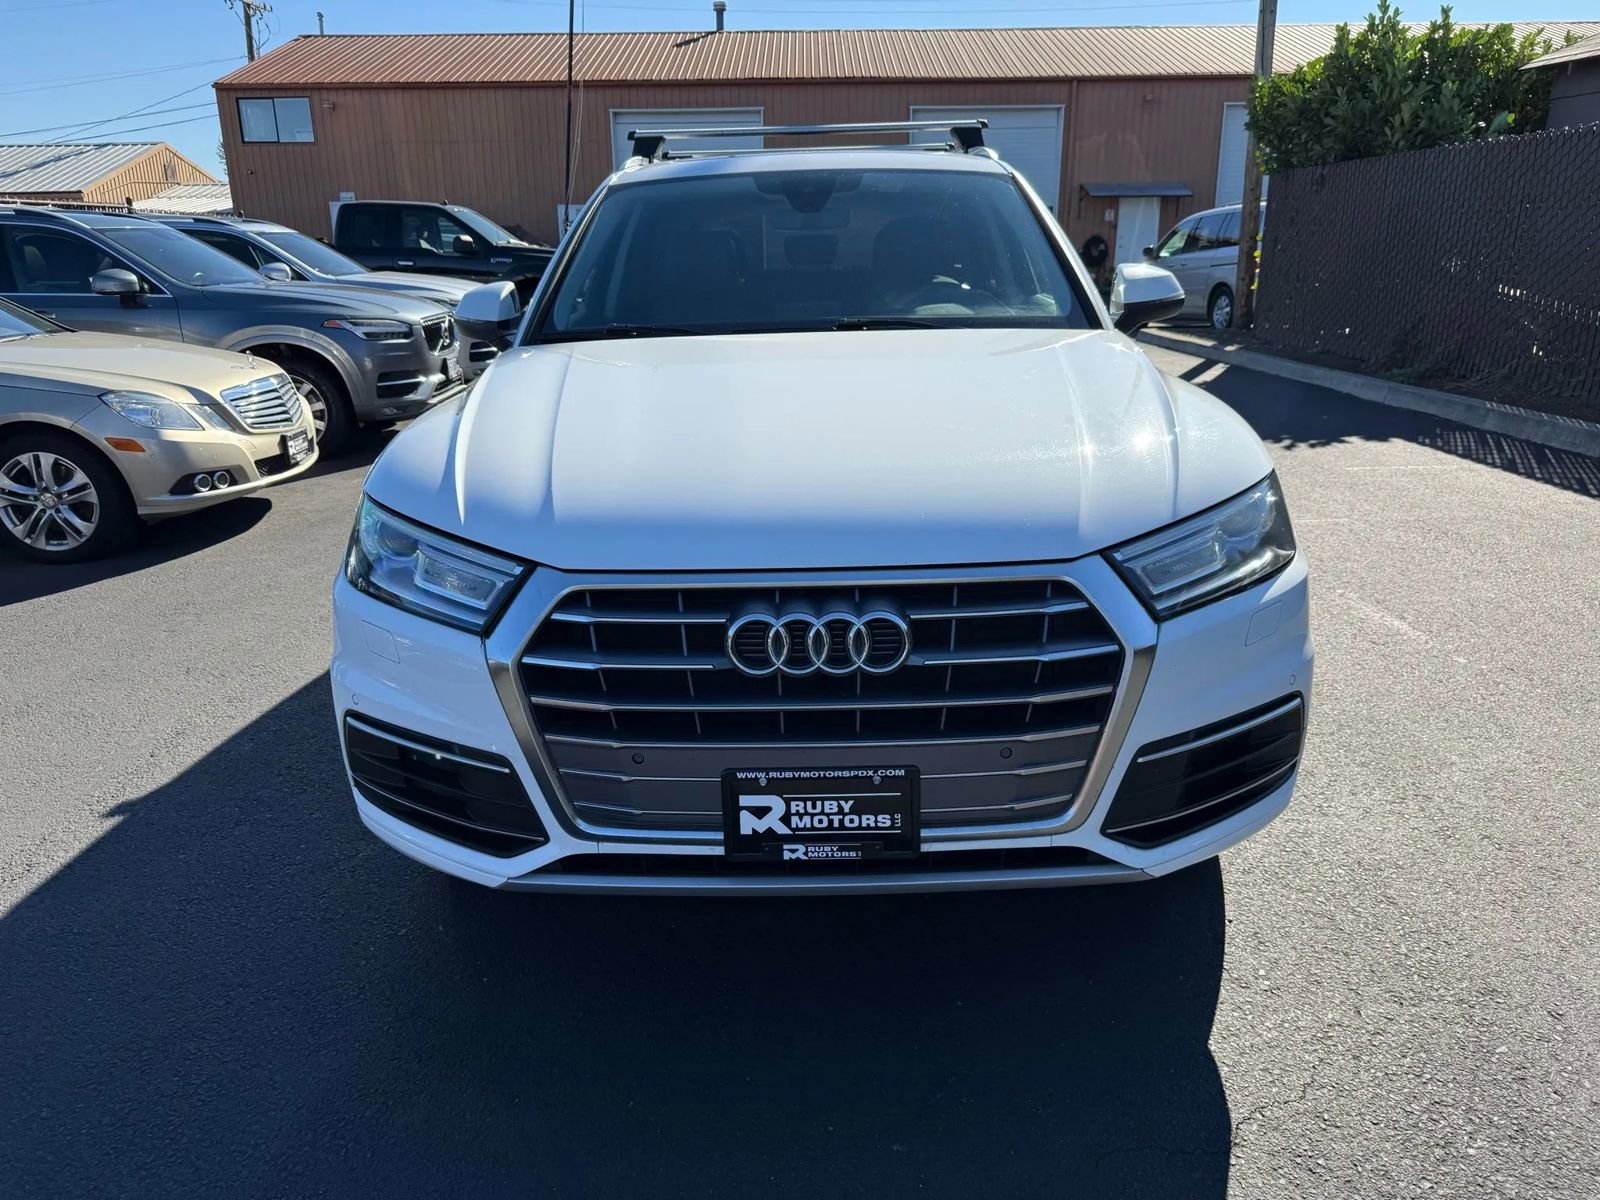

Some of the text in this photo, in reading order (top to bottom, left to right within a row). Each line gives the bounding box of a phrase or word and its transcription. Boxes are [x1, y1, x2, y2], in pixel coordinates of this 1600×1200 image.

[736, 769, 905, 778] WWW.RUBYMOTORSPDX.COM
[790, 800, 855, 814] RUBY
[791, 815, 891, 828] MOTORS
